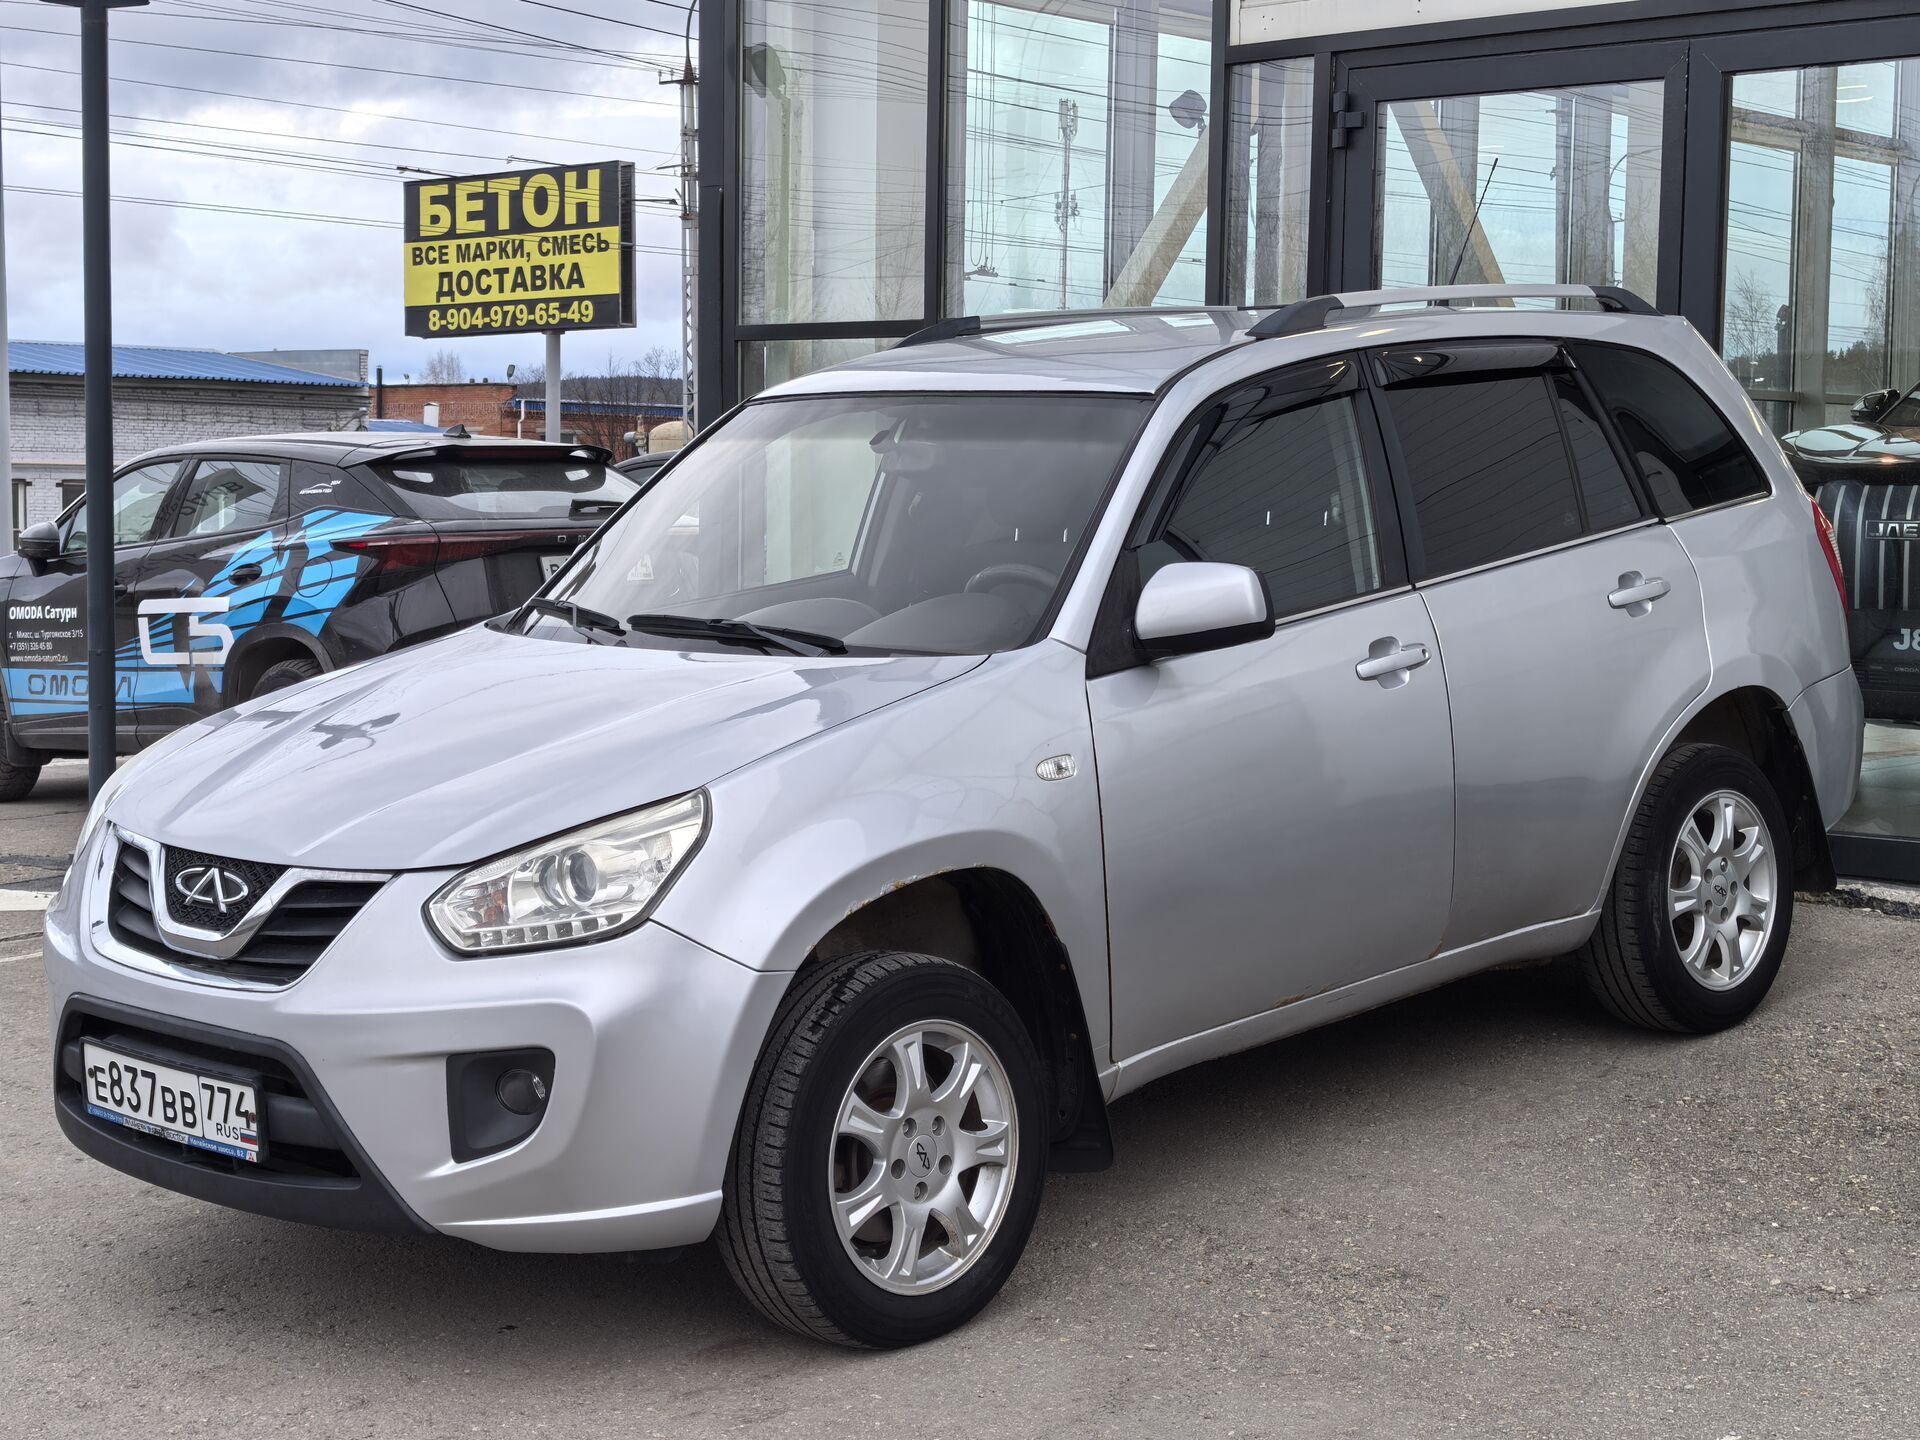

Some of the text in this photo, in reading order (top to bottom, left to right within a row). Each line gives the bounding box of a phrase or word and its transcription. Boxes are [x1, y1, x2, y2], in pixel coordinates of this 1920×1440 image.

[419, 168, 600, 237] БЕТОН
[412, 232, 610, 266] ВСЕ МАРКИ, СМЕСЬ
[436, 262, 585, 303] ДОСТАВКА
[428, 300, 594, 331] 8-904-979-65-49
[9, 605, 77, 622] OMODA Сатурн
[16, 631, 33, 639] Миасс,
[71, 629, 84, 638] 3/15
[17, 642, 29, 651] (351)
[216, 1123, 240, 1140] RUS
